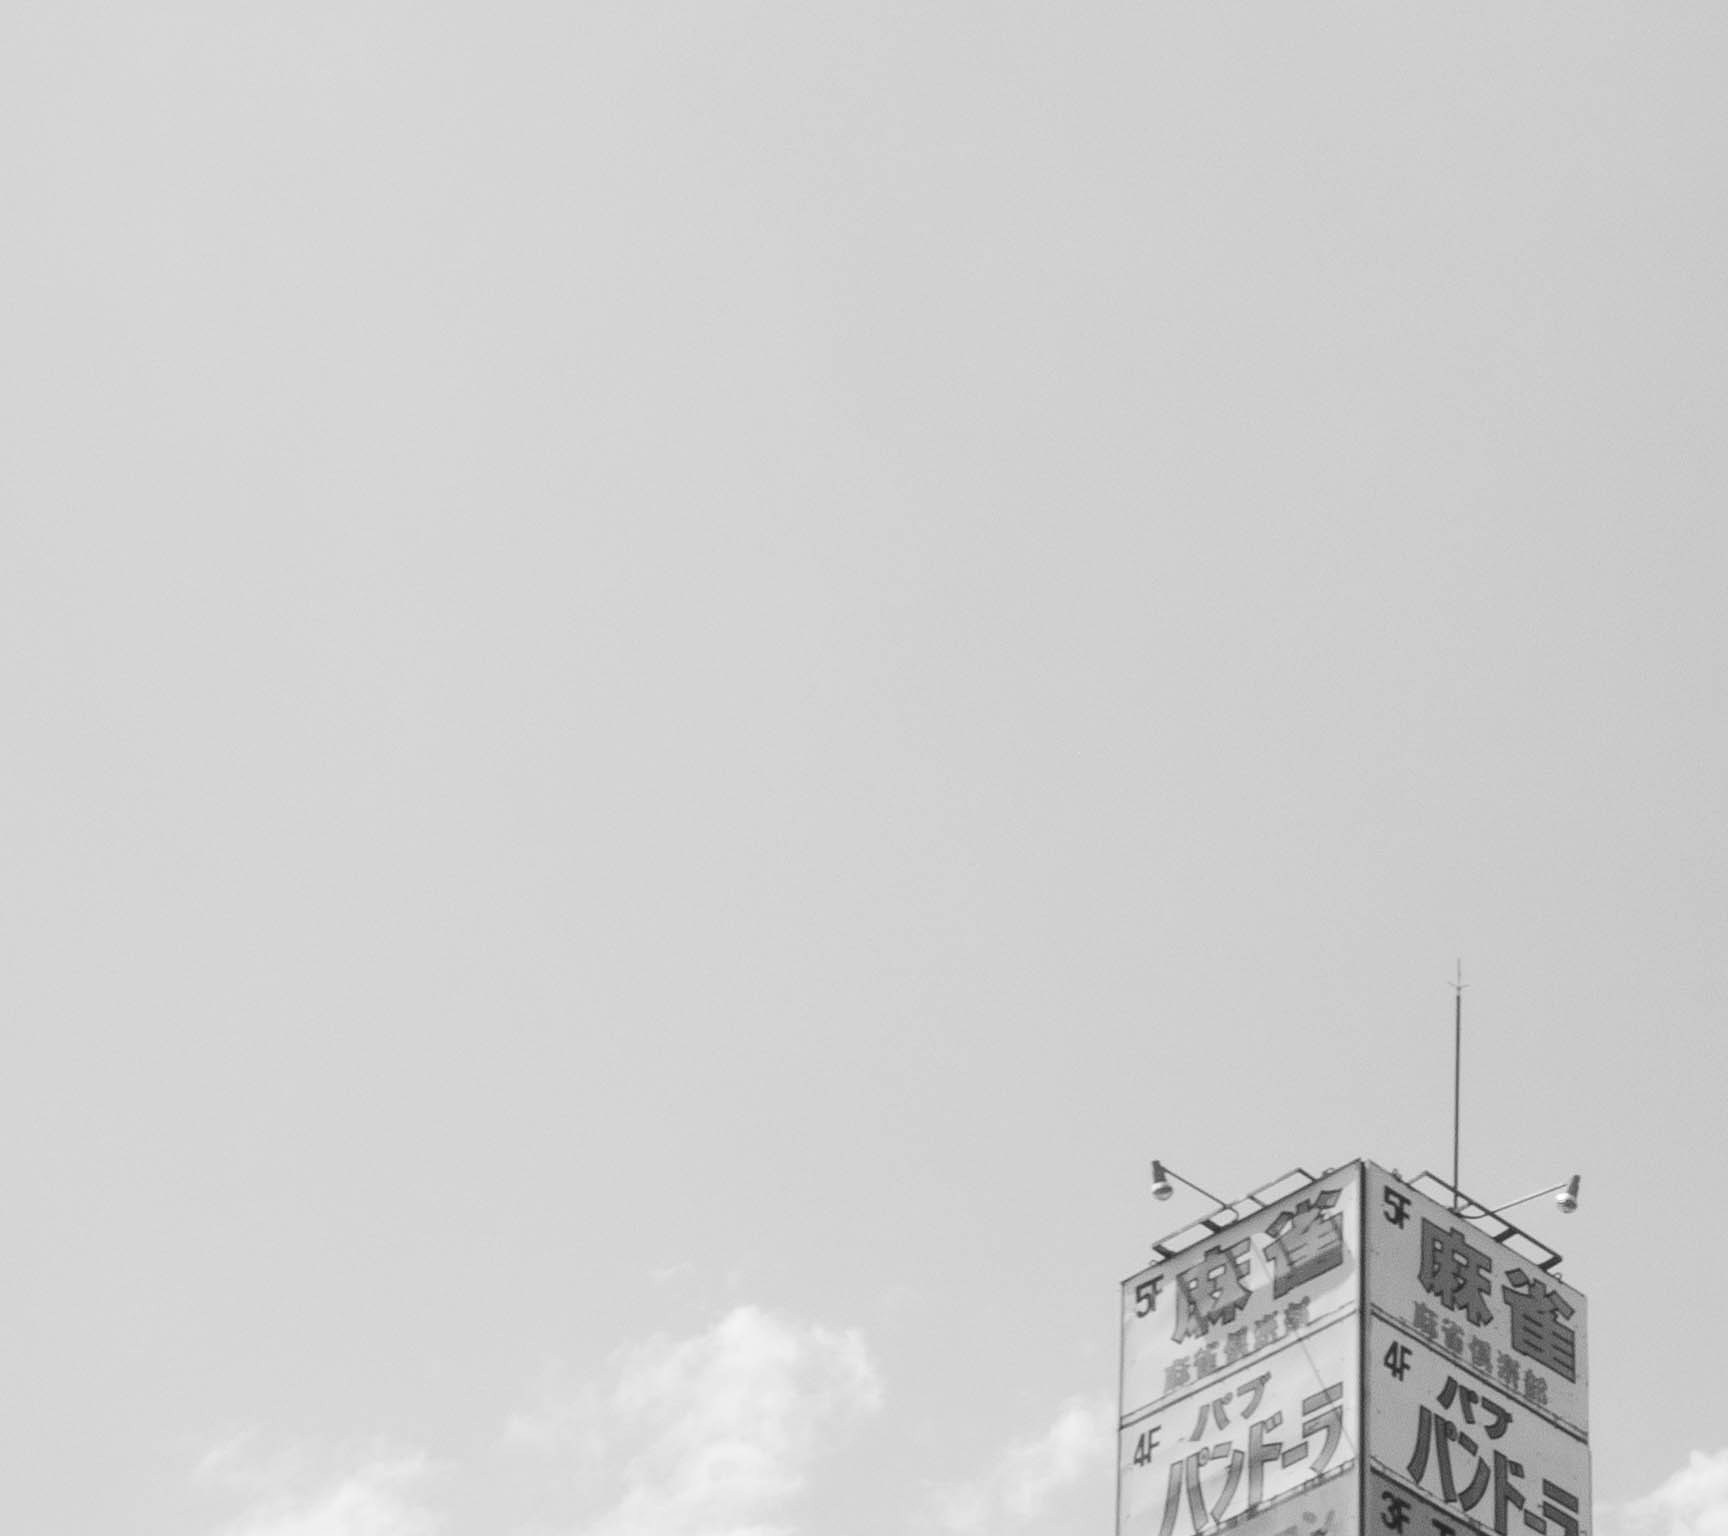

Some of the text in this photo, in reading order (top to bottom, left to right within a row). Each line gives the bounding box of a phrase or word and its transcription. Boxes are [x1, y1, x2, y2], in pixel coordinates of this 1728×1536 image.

[1383, 1186, 1411, 1230] 5F
[1171, 1189, 1343, 1344] 麻雀
[1134, 1274, 1163, 1318] 5F
[1418, 1216, 1576, 1384] 麻雀
[1384, 1341, 1412, 1381] 4F
[1134, 1424, 1161, 1466] 4F
[1381, 1491, 1411, 1534] 3F
